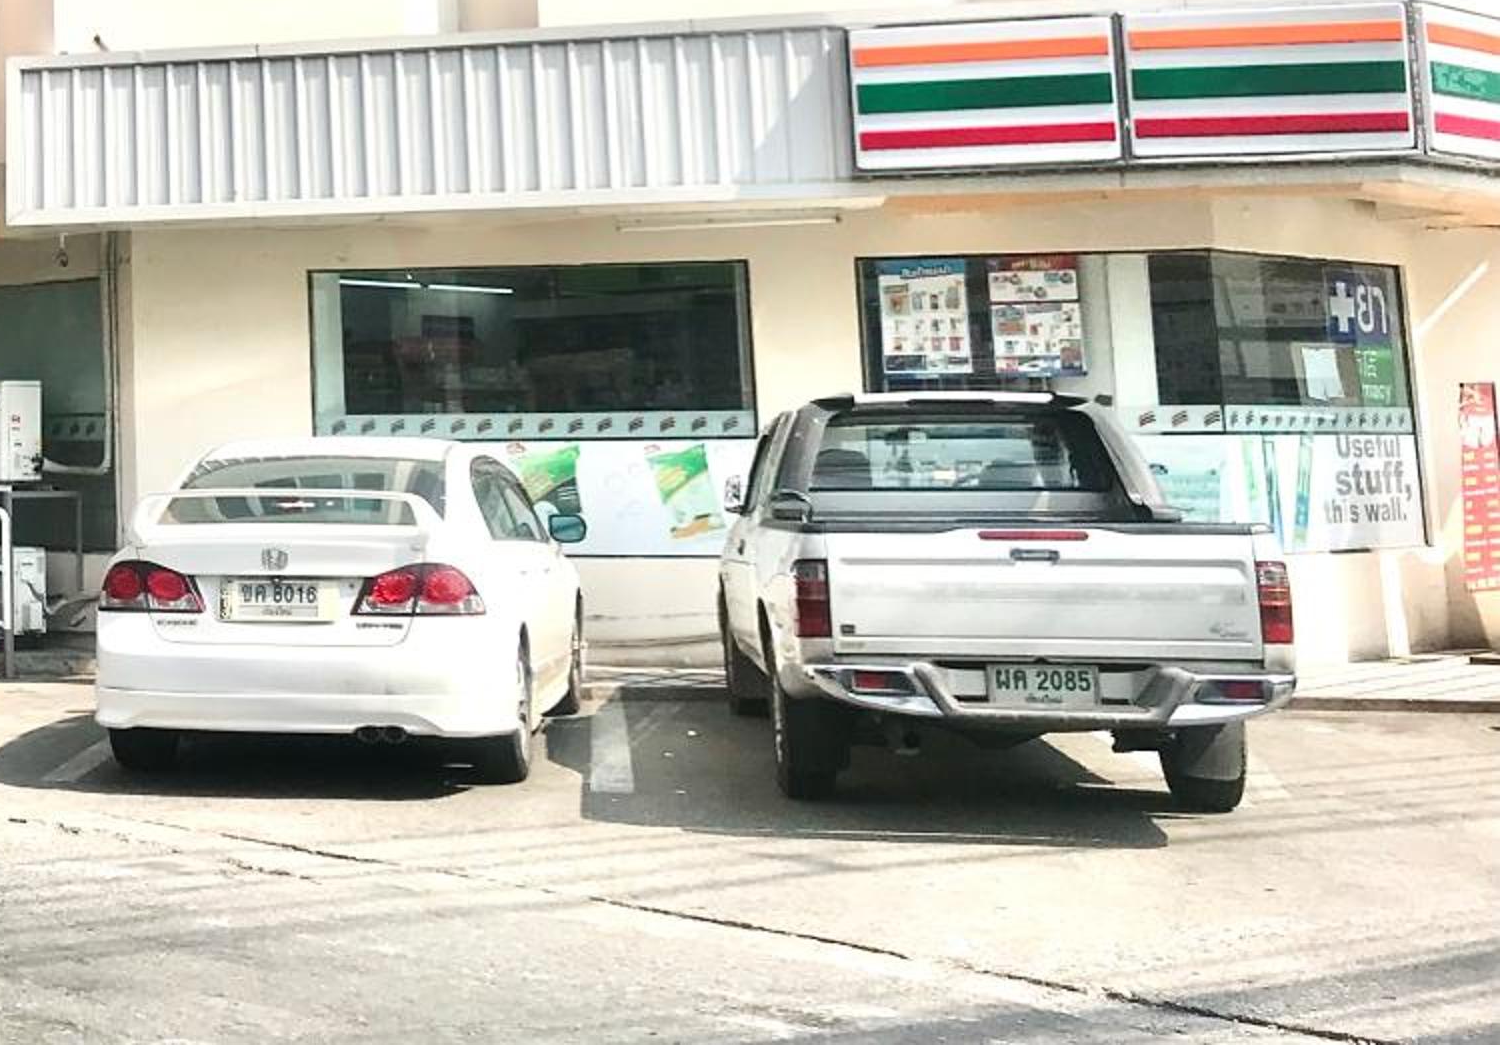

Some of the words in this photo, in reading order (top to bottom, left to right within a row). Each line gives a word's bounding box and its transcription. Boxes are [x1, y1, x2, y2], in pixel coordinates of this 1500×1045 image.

[1334, 459, 1413, 502] stuff,
[1364, 496, 1408, 523] wall.
[1036, 670, 1092, 692] 2085
